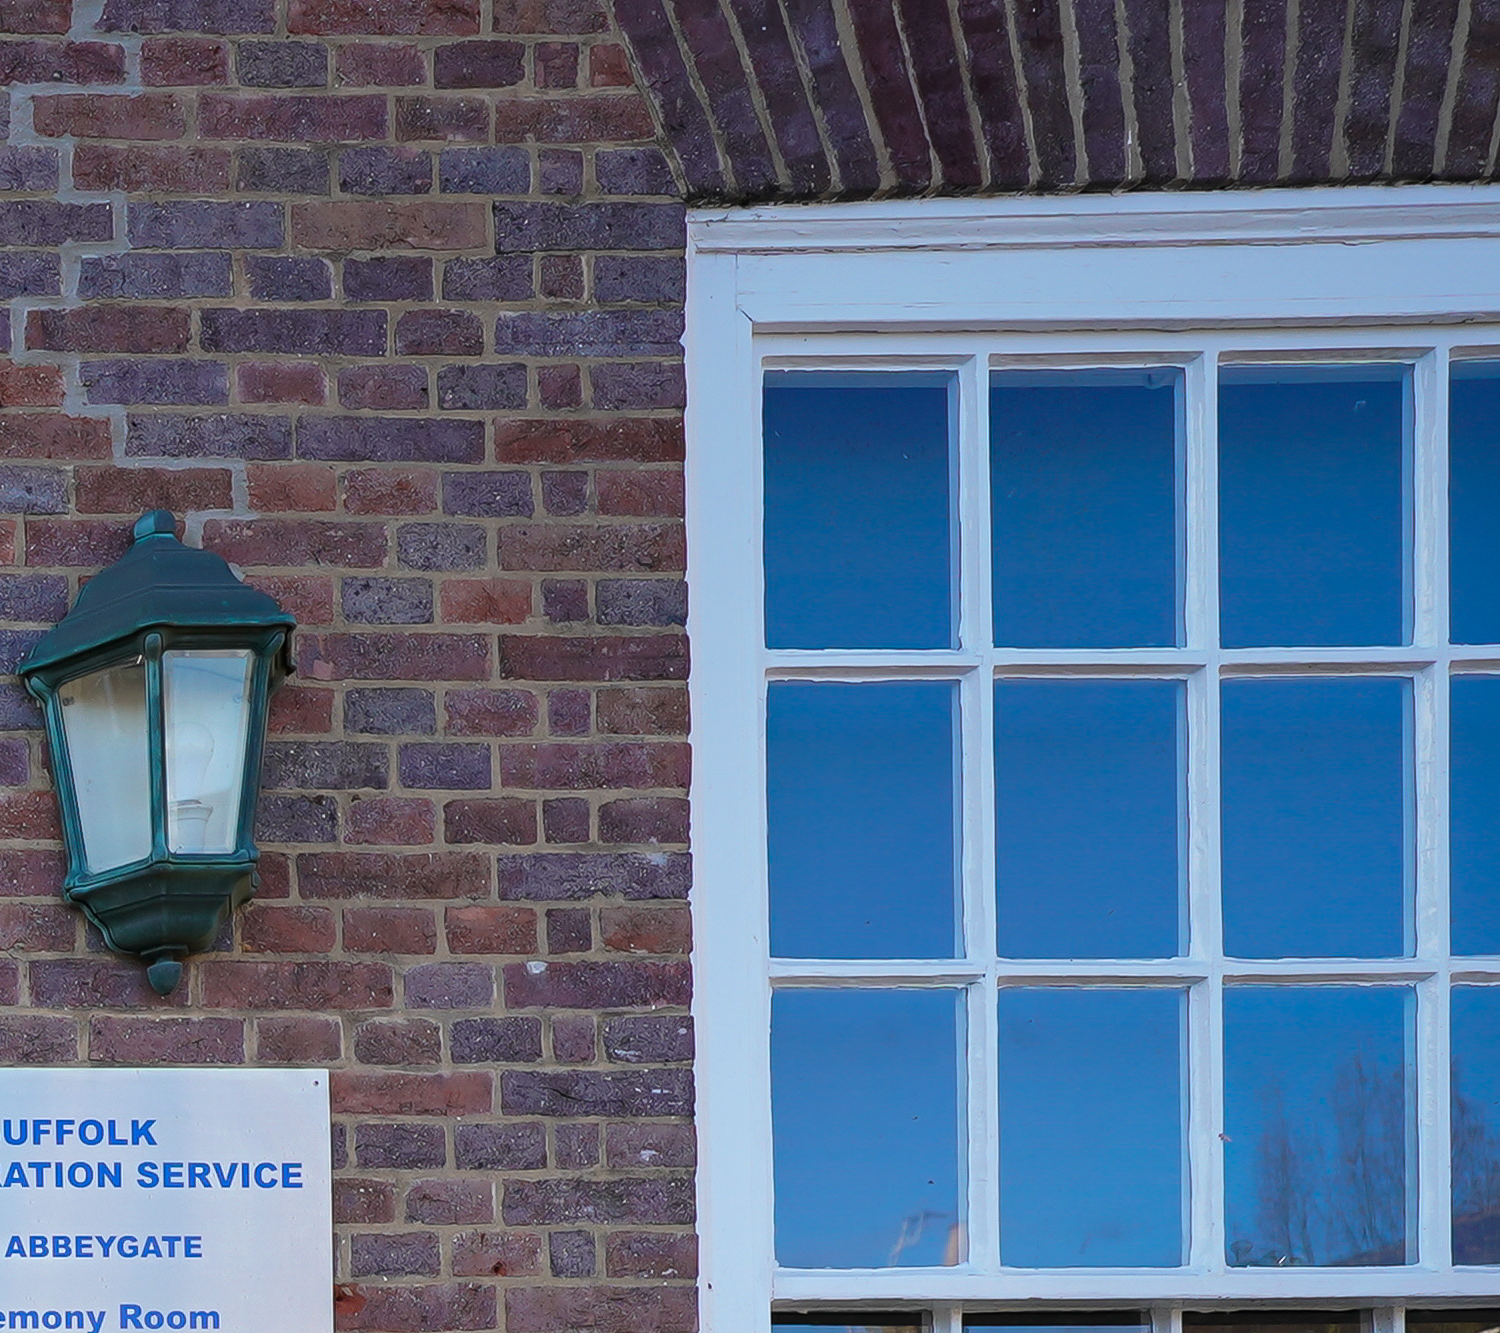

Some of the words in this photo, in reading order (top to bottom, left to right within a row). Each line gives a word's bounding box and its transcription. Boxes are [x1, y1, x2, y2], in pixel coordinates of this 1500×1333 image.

[136, 1161, 304, 1189] SERVICE
[5, 1235, 203, 1259] ABBEYGATE
[120, 1304, 220, 1330] Room
